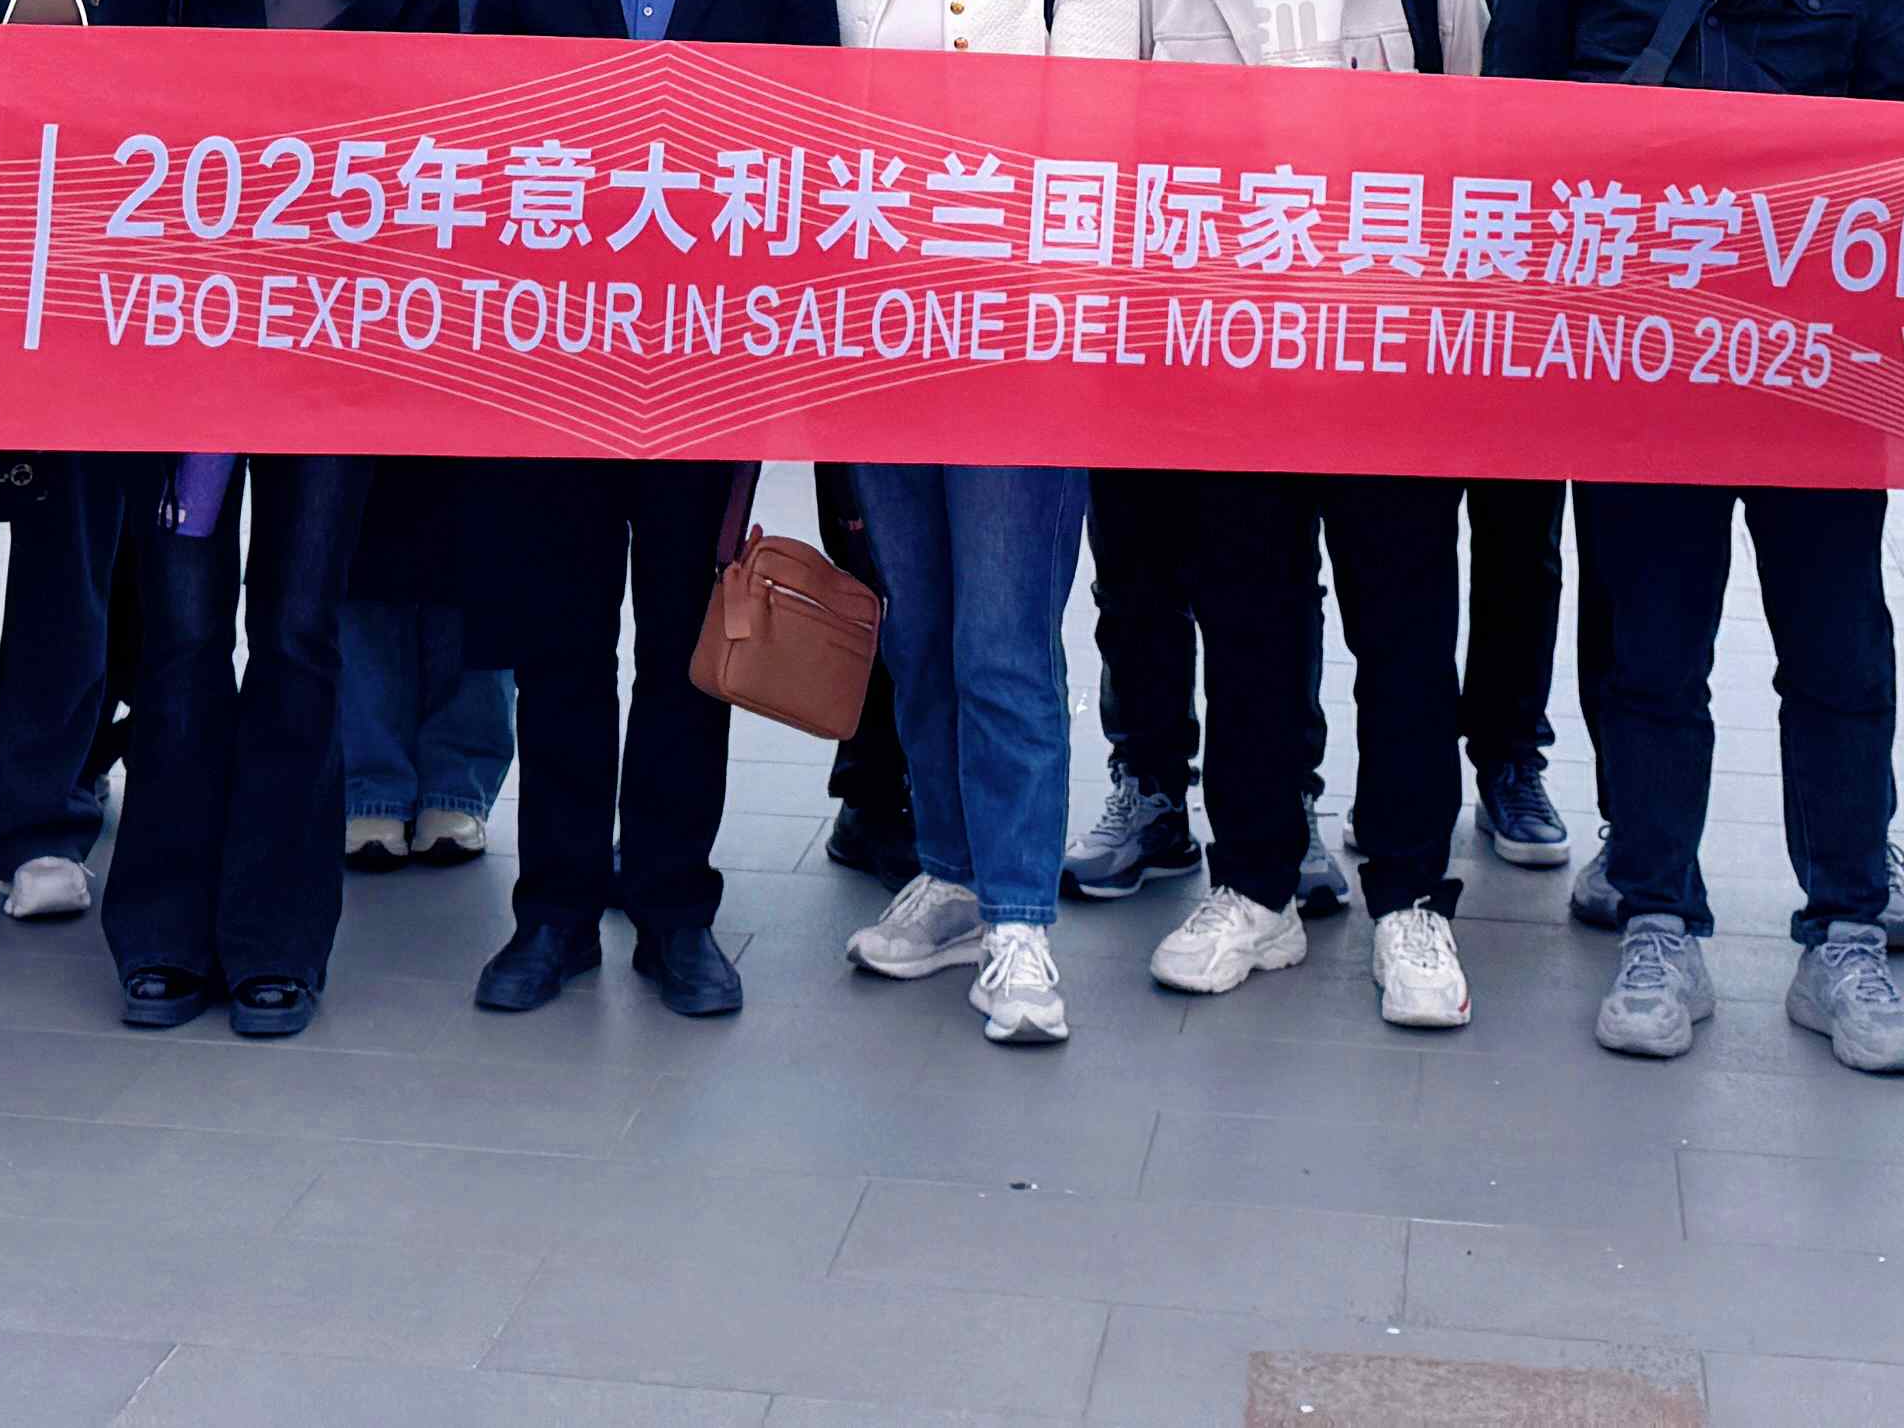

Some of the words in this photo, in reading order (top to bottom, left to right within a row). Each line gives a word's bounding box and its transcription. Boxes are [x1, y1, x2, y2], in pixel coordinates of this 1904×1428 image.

[99, 273, 241, 347] VBO
[258, 275, 443, 350] EXPO
[463, 279, 644, 353] TOUR
[663, 284, 726, 356] IN
[744, 285, 1007, 361] SALONE
[1027, 291, 1146, 366] DEL
[1165, 299, 1407, 373] MOBILE
[1426, 307, 1672, 383] MILANO
[1690, 317, 1832, 389] 2025
